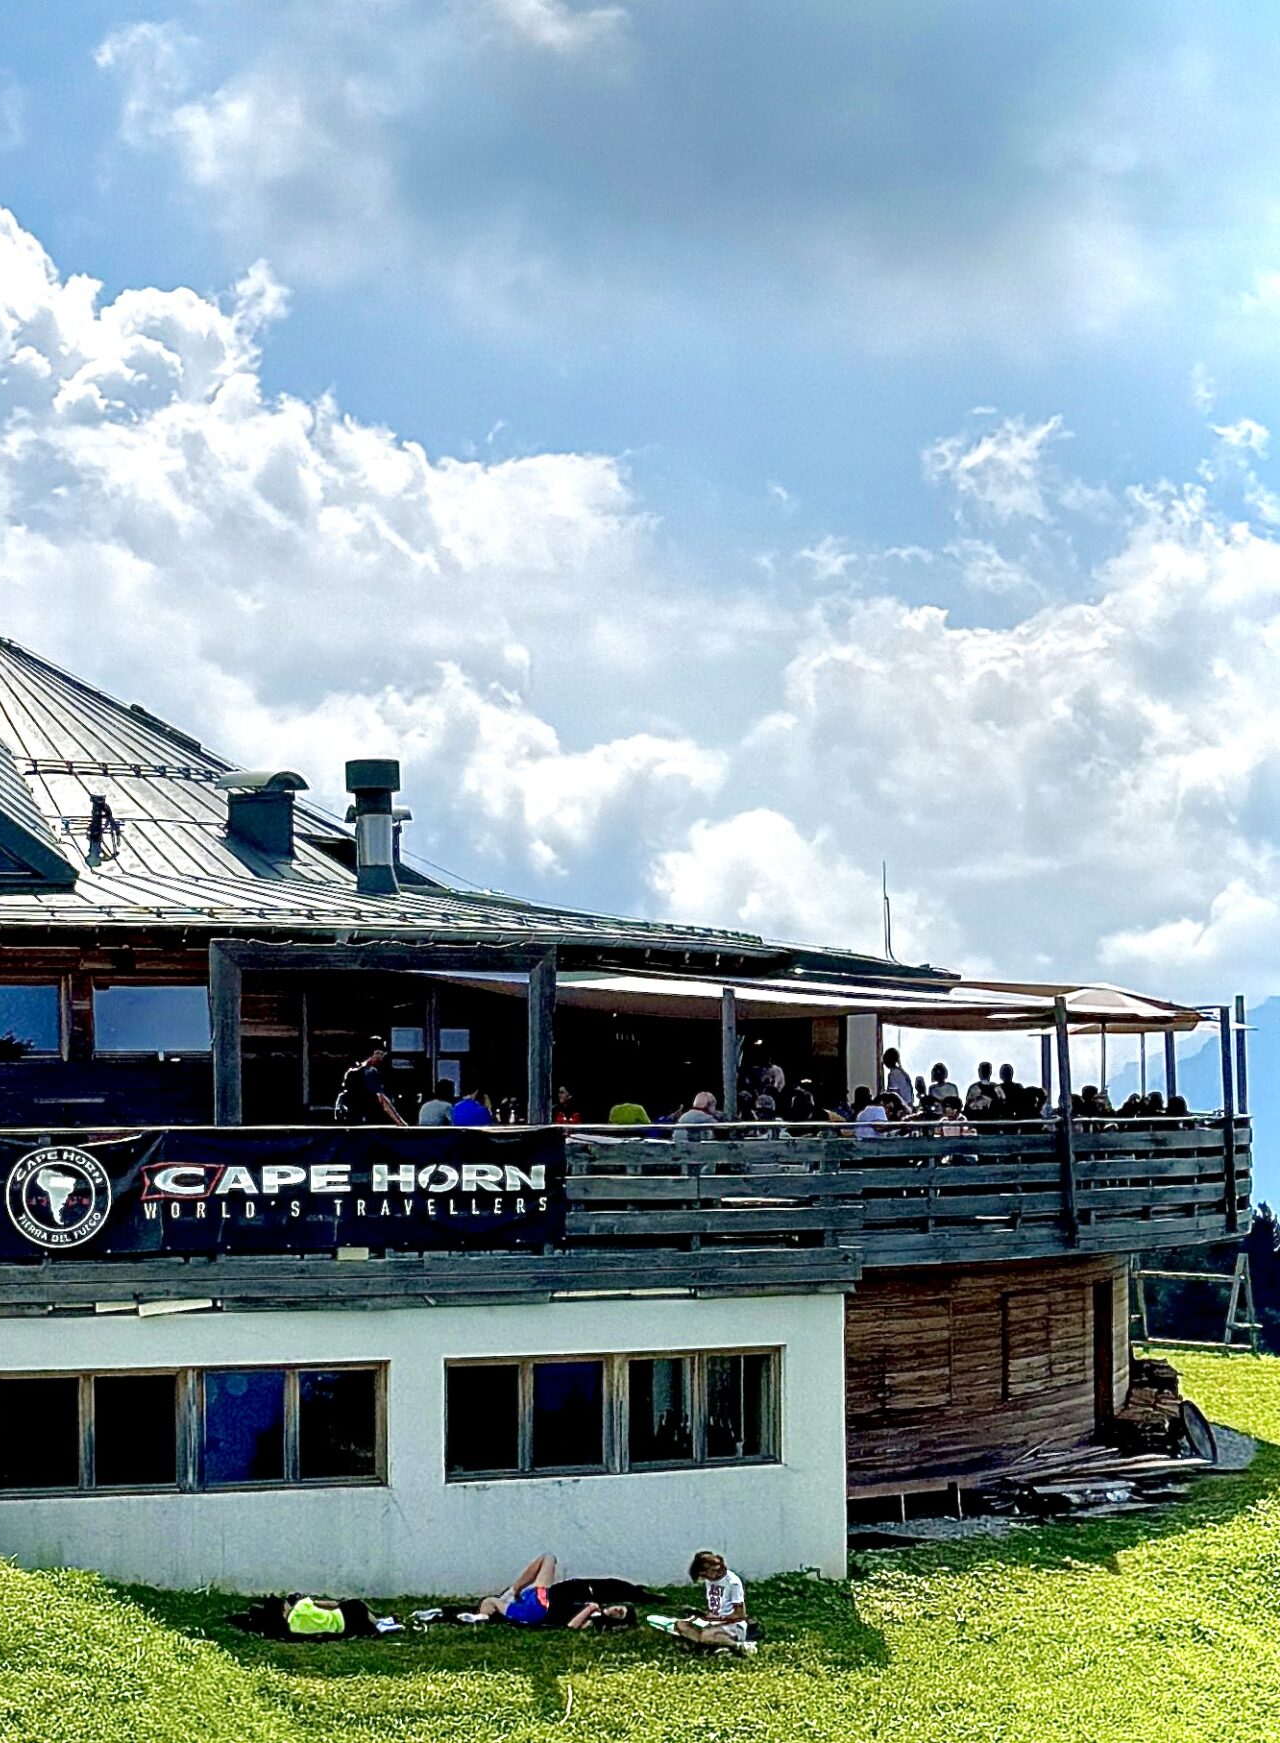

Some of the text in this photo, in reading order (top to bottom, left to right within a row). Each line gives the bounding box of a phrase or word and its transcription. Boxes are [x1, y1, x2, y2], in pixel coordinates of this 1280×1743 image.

[16, 1150, 103, 1184] CAPE HORN
[153, 1163, 546, 1194] CAPE HORN
[143, 1201, 301, 1219] WORLD'S
[334, 1197, 549, 1217] TRAVELLERS
[18, 1212, 101, 1243] TIERRA DEL FUEGO
